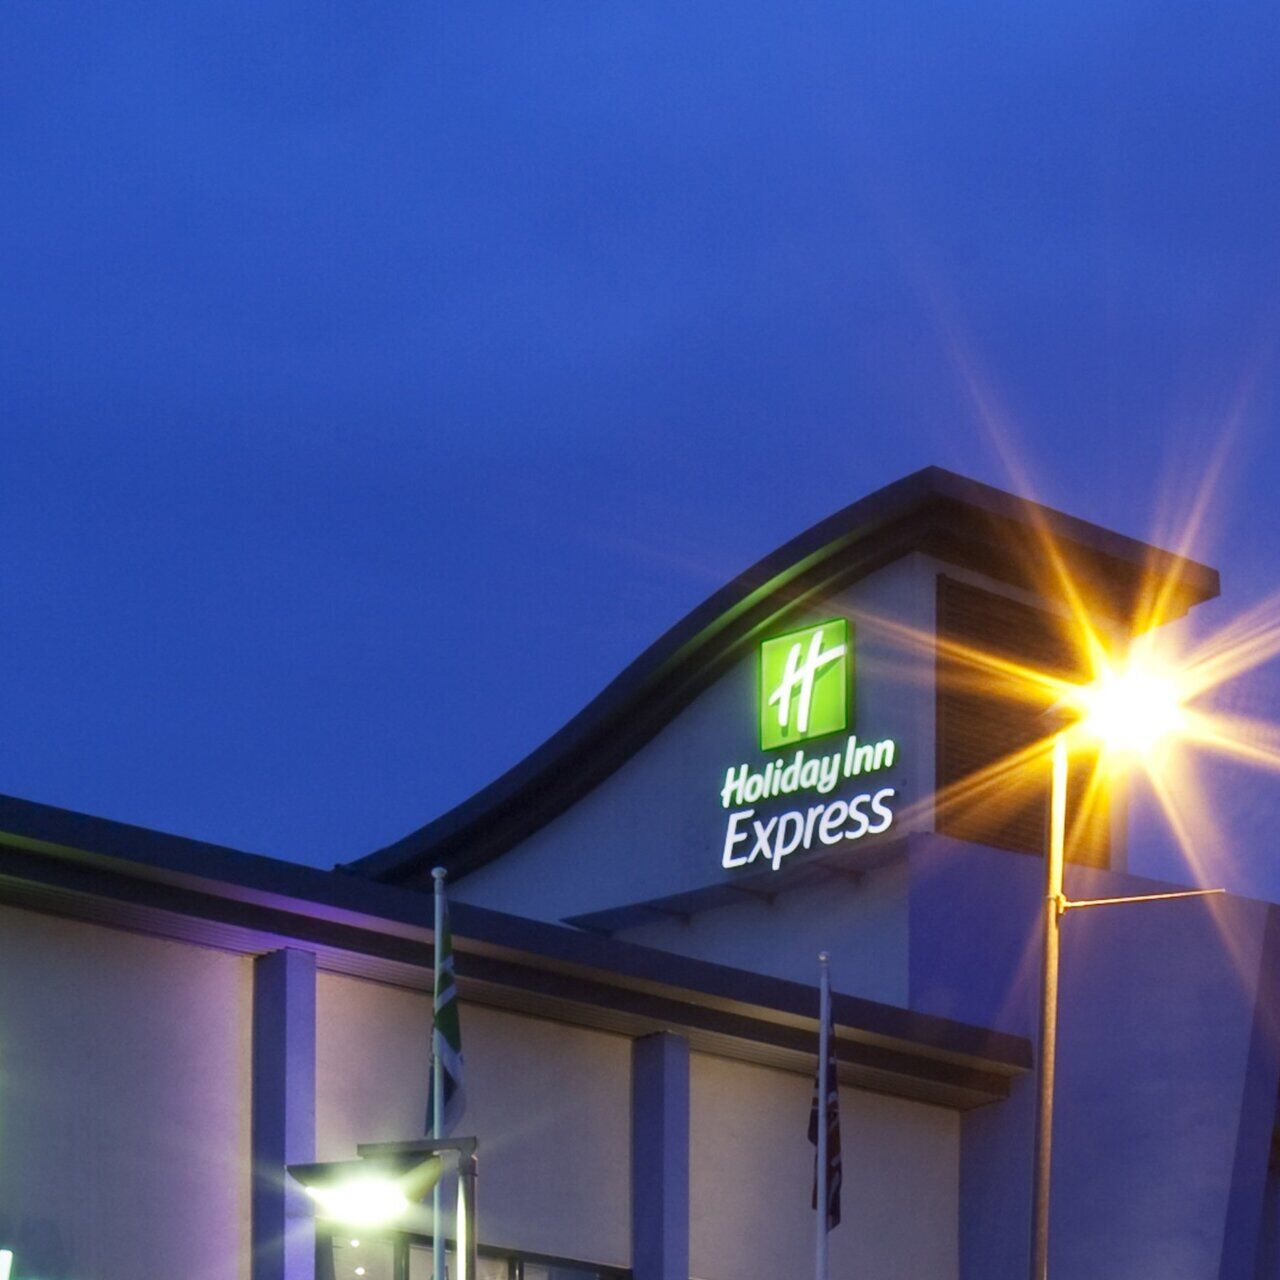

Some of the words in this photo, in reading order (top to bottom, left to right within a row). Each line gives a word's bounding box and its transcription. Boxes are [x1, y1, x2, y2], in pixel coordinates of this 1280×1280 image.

[768, 630, 846, 732] H
[721, 750, 841, 808] Holiday
[844, 735, 895, 777] Inn
[722, 788, 895, 871] Express
